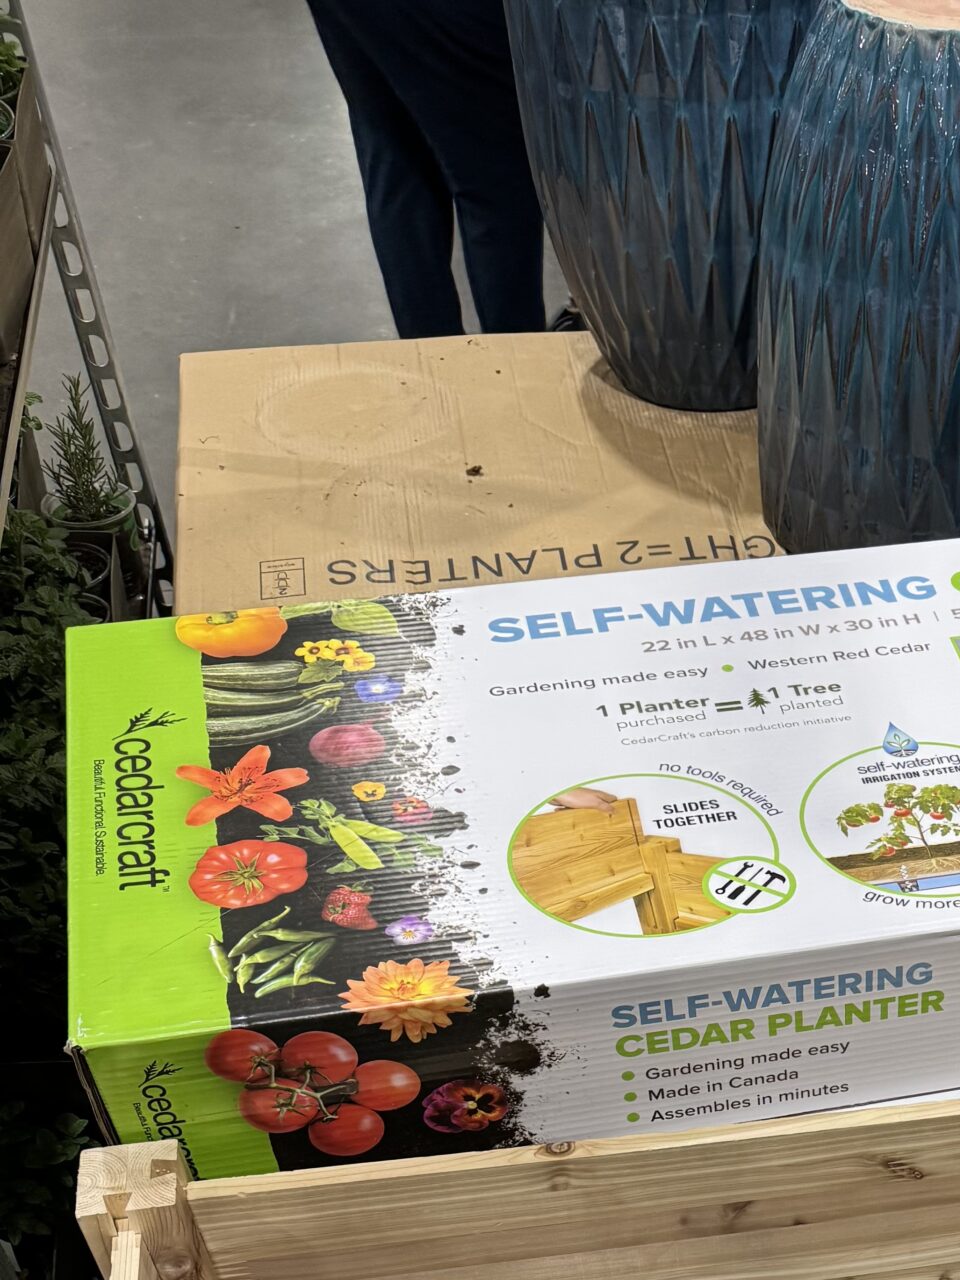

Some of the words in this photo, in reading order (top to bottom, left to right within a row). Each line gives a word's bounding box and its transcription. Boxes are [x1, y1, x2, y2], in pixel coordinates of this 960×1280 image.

[327, 543, 602, 586] PLANTERS
[488, 576, 937, 643] SELF-WATERING
[641, 640, 672, 653] 22
[677, 637, 697, 650] in
[702, 635, 716, 647] L
[722, 633, 735, 645] x
[740, 630, 769, 643] 48
[774, 627, 794, 640] in
[797, 624, 821, 637] W
[827, 624, 841, 634] x
[844, 619, 873, 632] 30
[878, 616, 898, 629] in
[902, 613, 921, 626] H
[489, 675, 596, 697] Gardening
[602, 670, 657, 687] made
[664, 665, 708, 679] easy
[748, 655, 828, 671] Western
[832, 648, 870, 661] Red
[875, 642, 931, 657] Cedar
[596, 705, 609, 717] 1
[619, 697, 710, 716] Planter
[767, 687, 779, 699] 1
[787, 683, 842, 697] Tree
[616, 710, 707, 732] purchased
[779, 696, 844, 715] planted
[699, 726, 740, 738] carbon
[744, 720, 799, 733] reduction
[803, 715, 852, 726] initiative
[659, 763, 681, 773] no
[686, 765, 726, 783] tools
[726, 778, 783, 817] required
[861, 770, 921, 785] IRRIGATION
[94, 792, 106, 829] Functional
[114, 738, 170, 891] cedarcraft
[653, 811, 738, 829] TOGETHER
[662, 799, 720, 815] SLIDES
[863, 890, 910, 910] grow
[611, 962, 933, 1029] SELF-WATERING
[615, 1018, 755, 1058] CEDAR
[767, 990, 945, 1037] PLANTER
[645, 1055, 745, 1080] Gardening
[751, 1046, 802, 1065] made
[807, 1040, 851, 1057] easy
[648, 1083, 701, 1101] Made
[706, 1080, 723, 1092] in
[729, 1069, 799, 1090] Canada
[651, 1097, 751, 1123] Assembles
[756, 1093, 772, 1106] in
[778, 1080, 850, 1103] minutes
